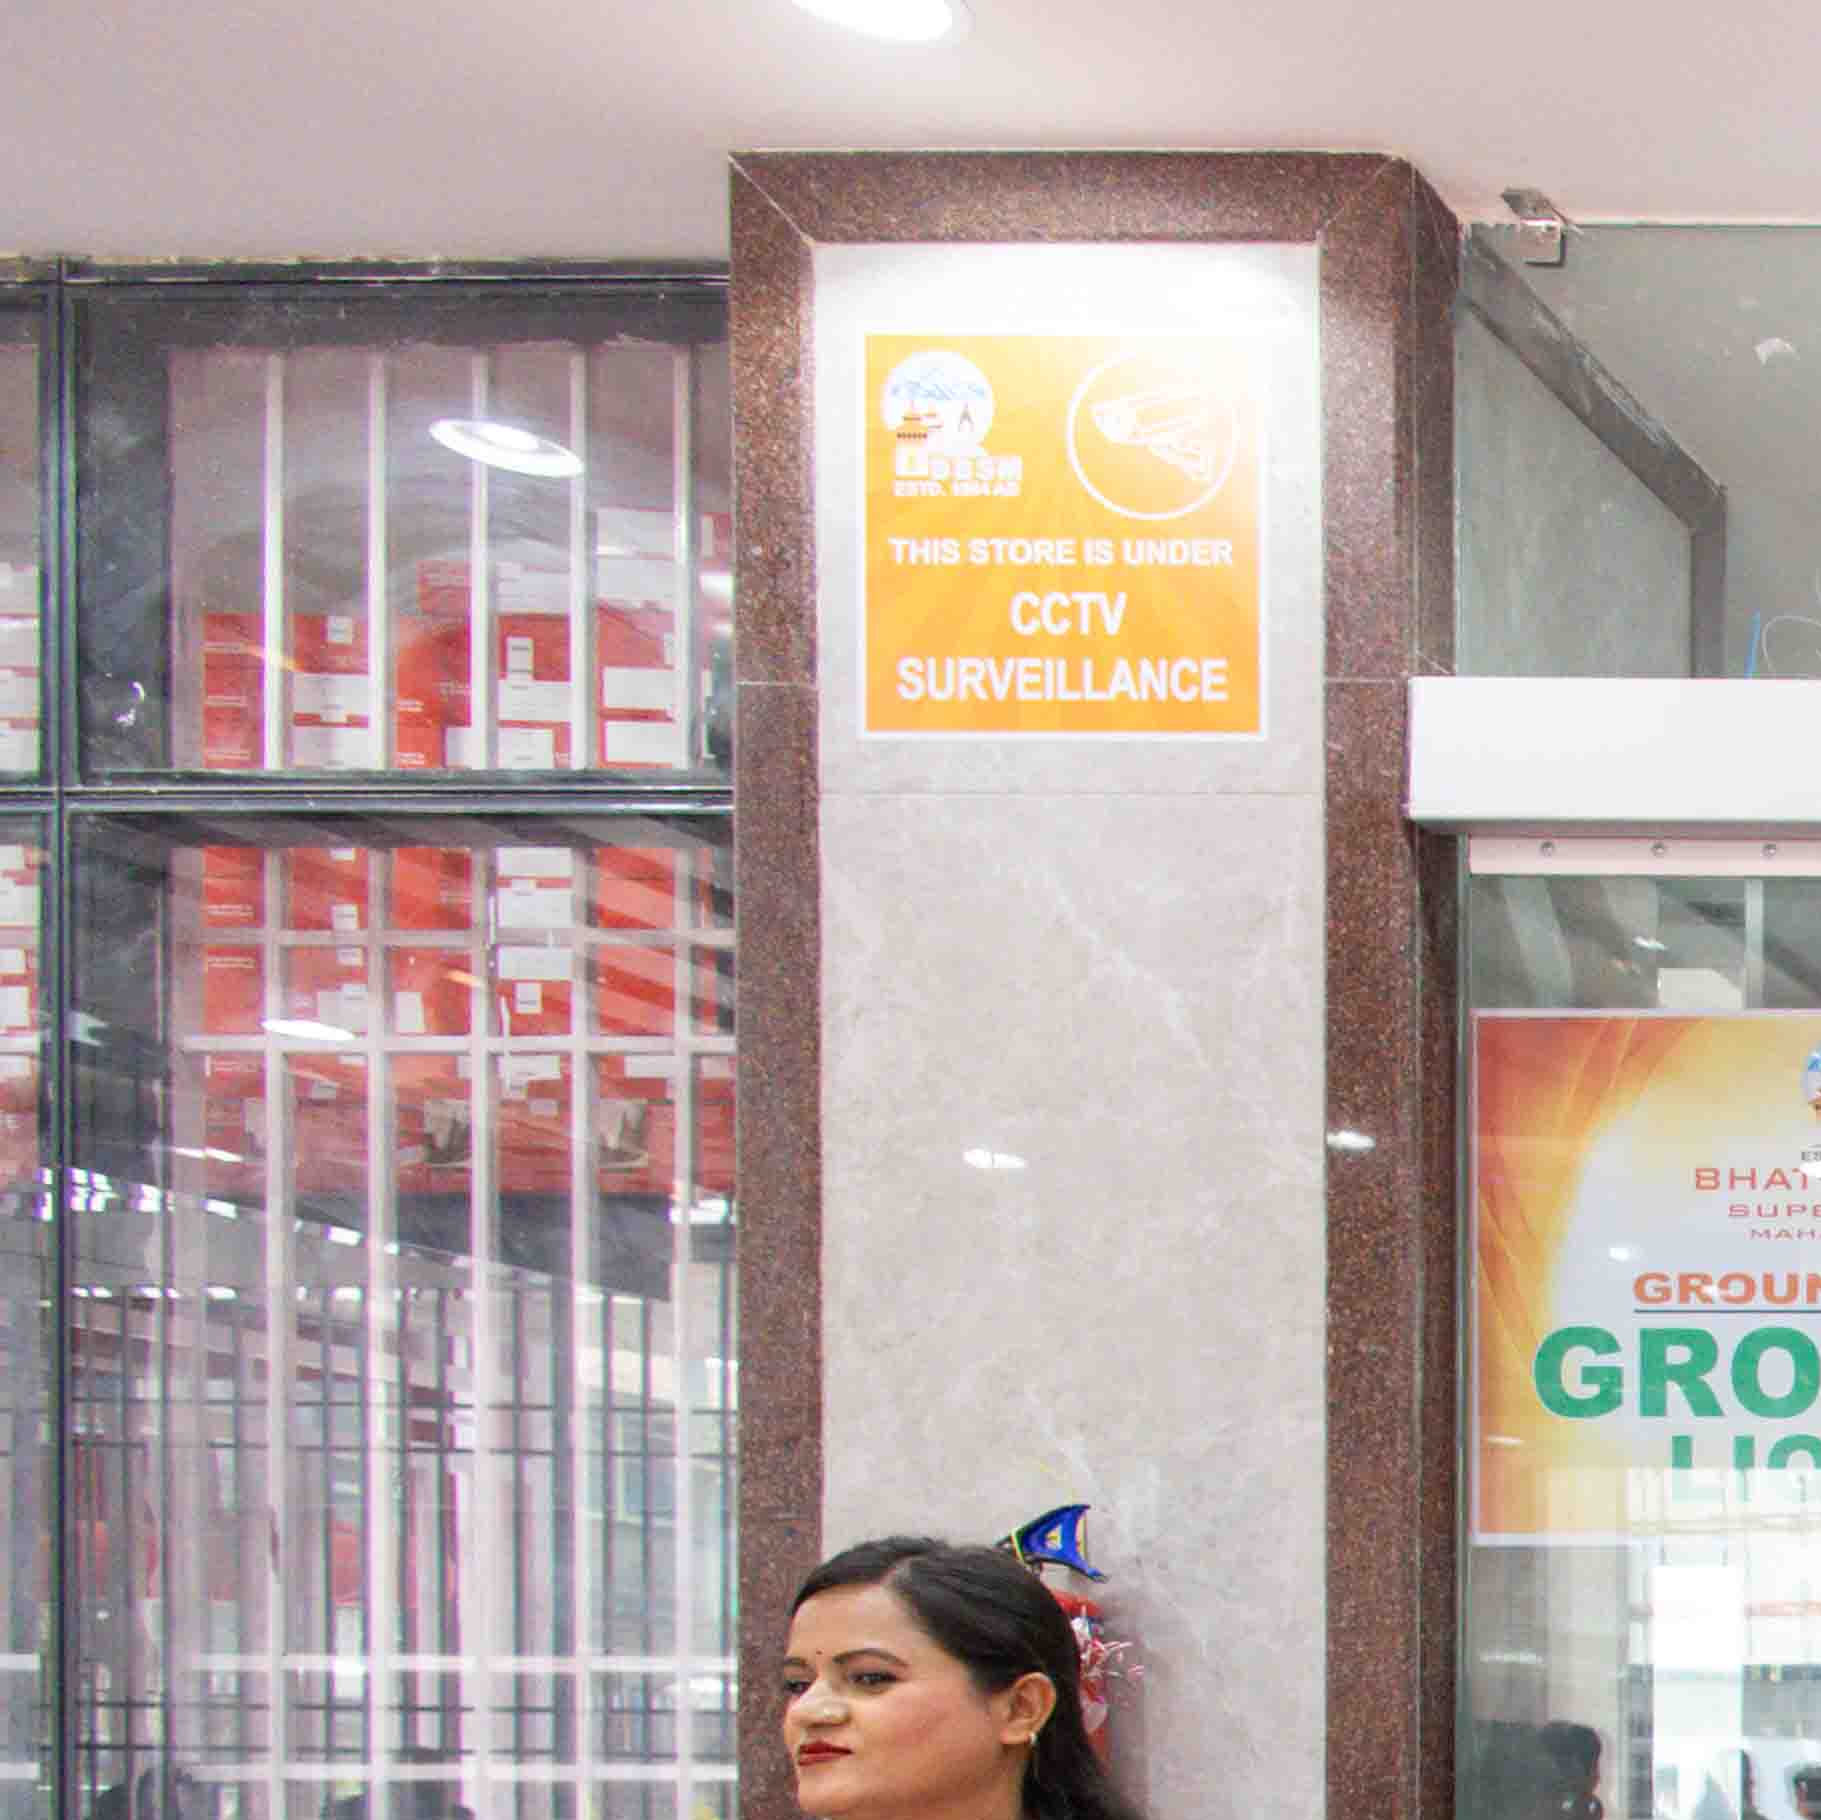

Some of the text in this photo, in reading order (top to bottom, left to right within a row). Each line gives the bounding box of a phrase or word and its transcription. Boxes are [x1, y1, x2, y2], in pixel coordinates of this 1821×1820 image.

[888, 537, 1233, 567] THIS STORE IS UNDER
[1008, 590, 1128, 638] CCTV
[895, 656, 1230, 702] SURVEILLANCE
